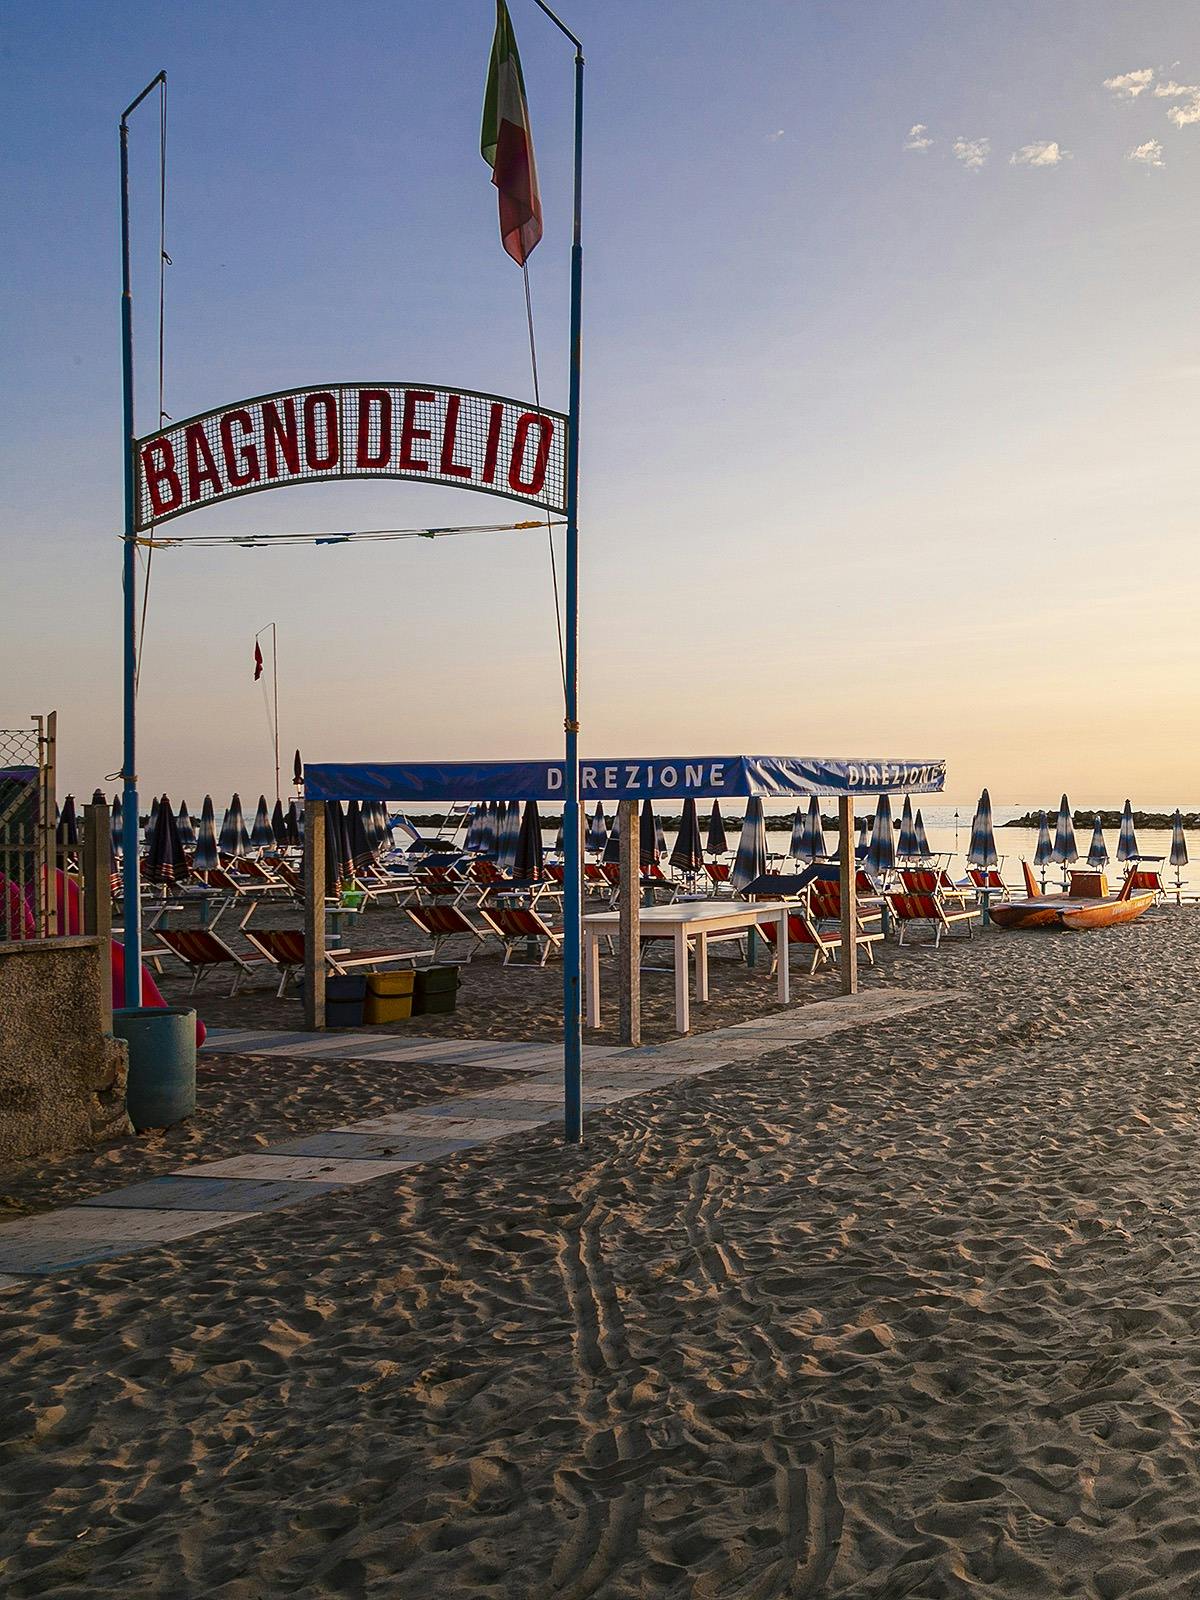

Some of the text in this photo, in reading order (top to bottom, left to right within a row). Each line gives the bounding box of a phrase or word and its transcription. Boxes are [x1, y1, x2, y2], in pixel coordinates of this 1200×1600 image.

[140, 389, 555, 516] BAGNO DELIO
[547, 763, 725, 790] DREZIONE
[848, 764, 941, 786] DIREZIONE
